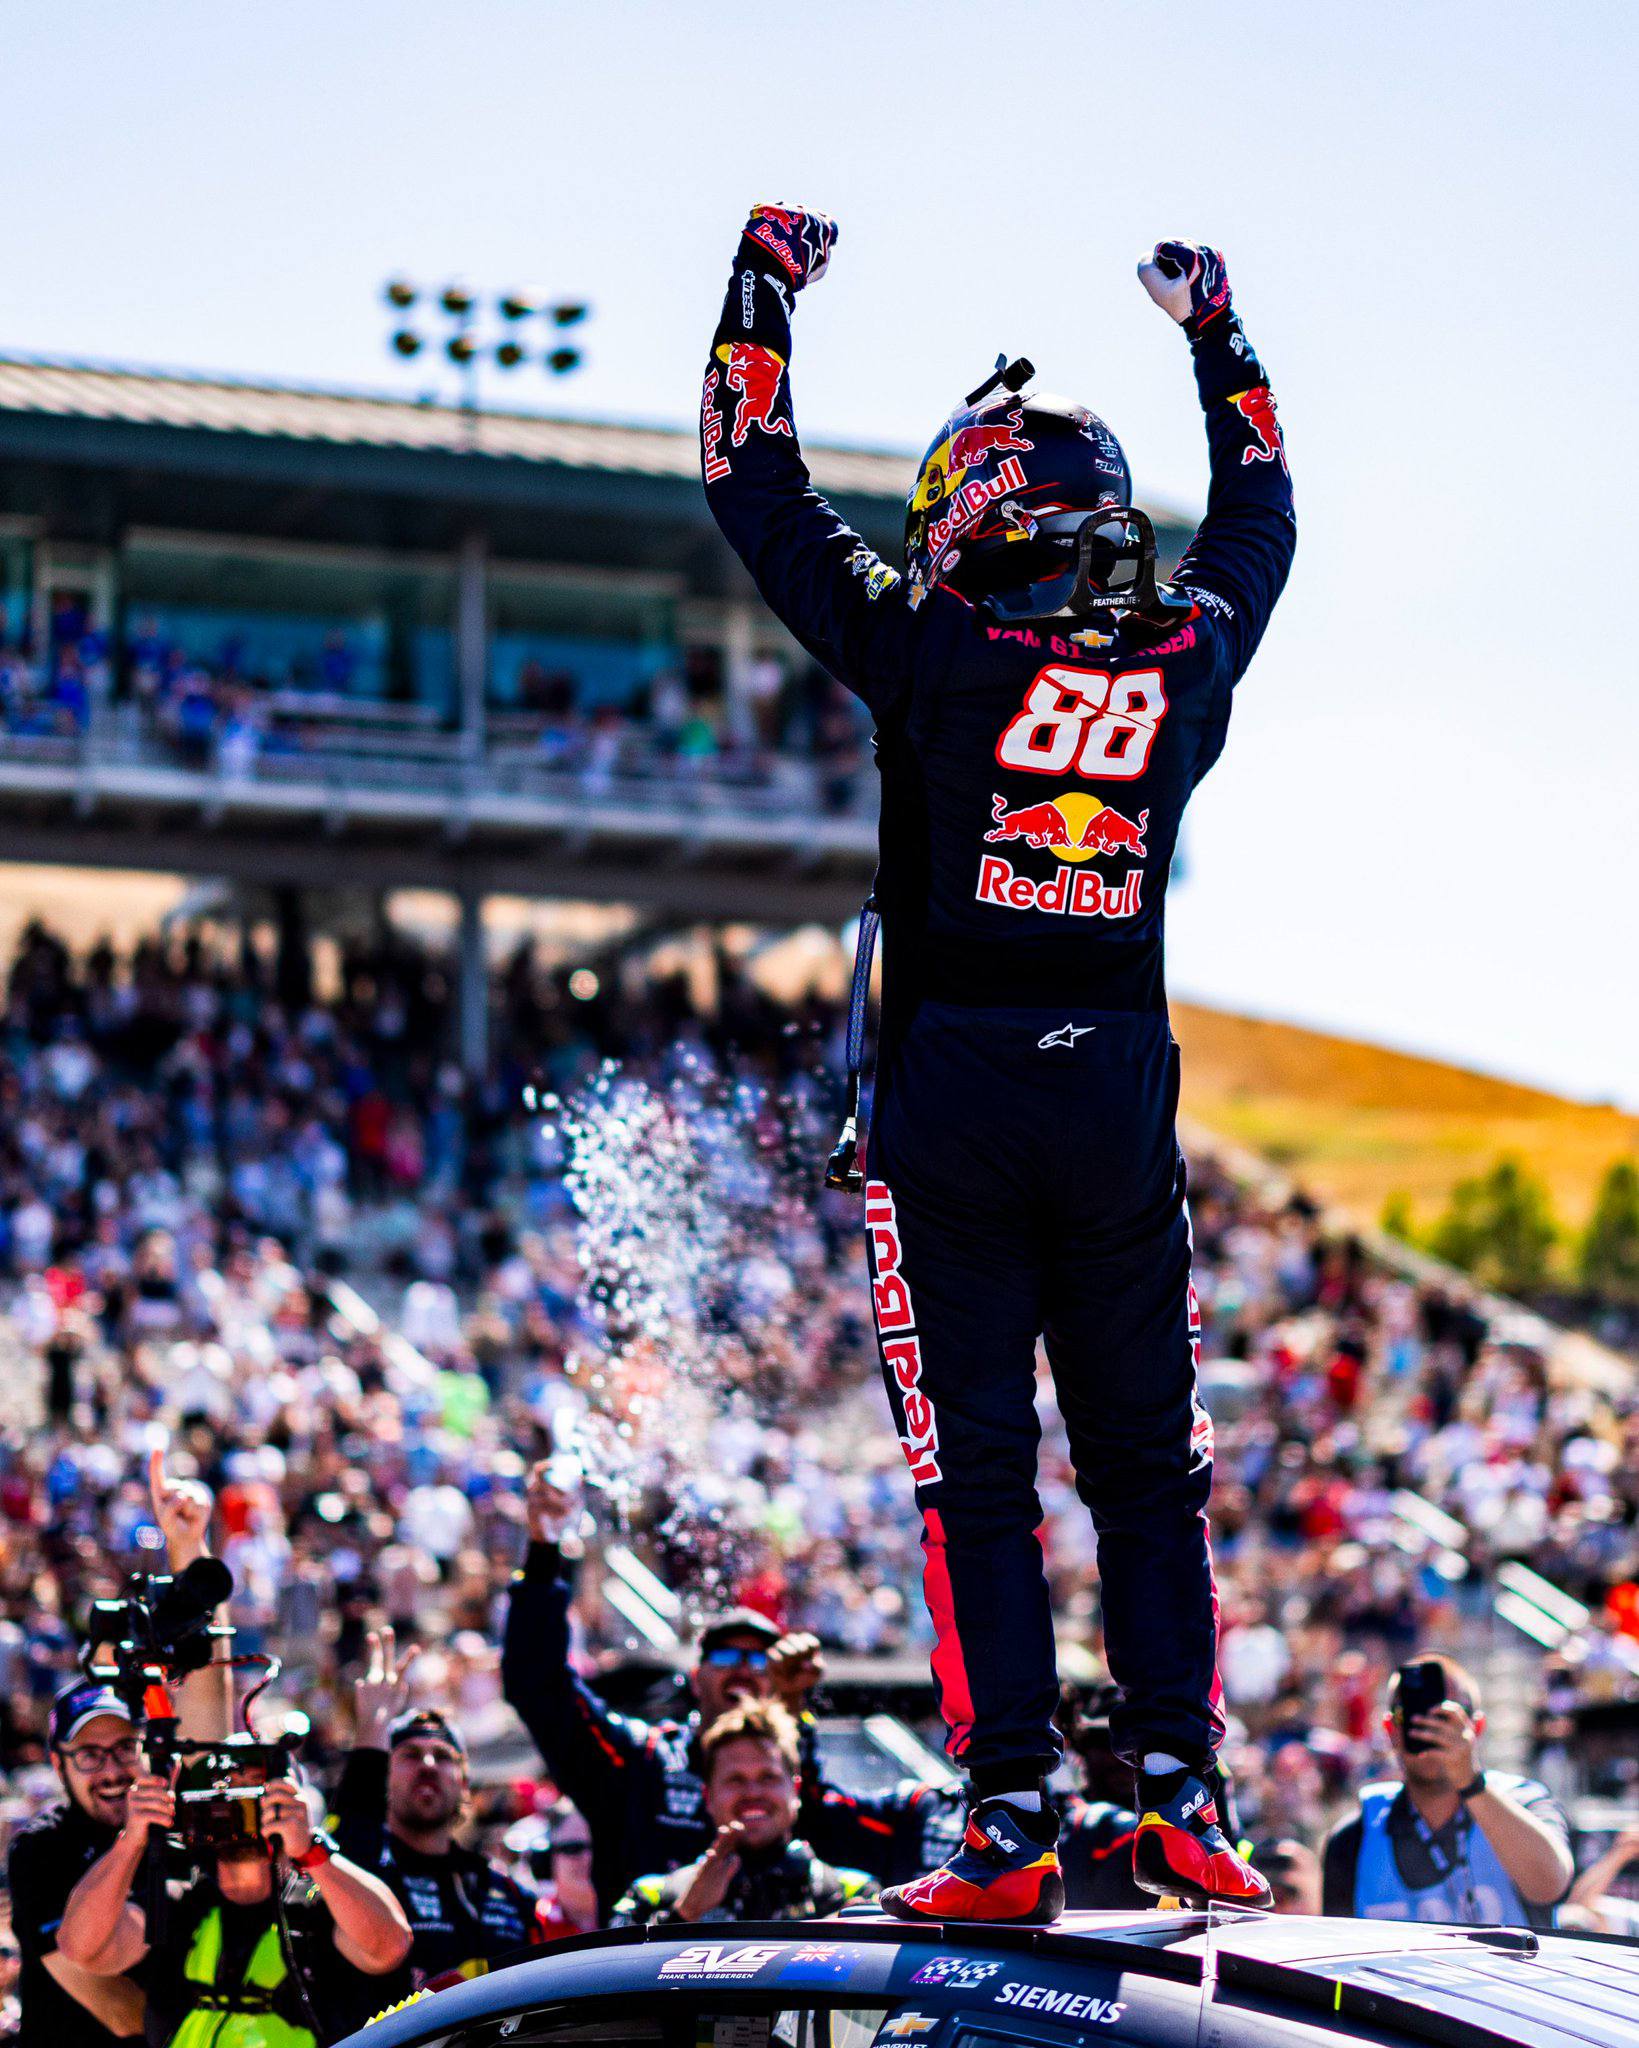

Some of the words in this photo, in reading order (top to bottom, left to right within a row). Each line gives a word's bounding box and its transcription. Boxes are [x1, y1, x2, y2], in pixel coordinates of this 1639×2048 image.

[943, 552, 959, 570] BELL
[1093, 597, 1136, 607] FEATHERLITE
[995, 663, 1169, 780] 88
[1181, 1789, 1206, 1820] SVG
[986, 1825, 1020, 1854] SVG
[660, 1945, 791, 1973] SVG
[994, 1982, 1129, 2024] SIEMENS
